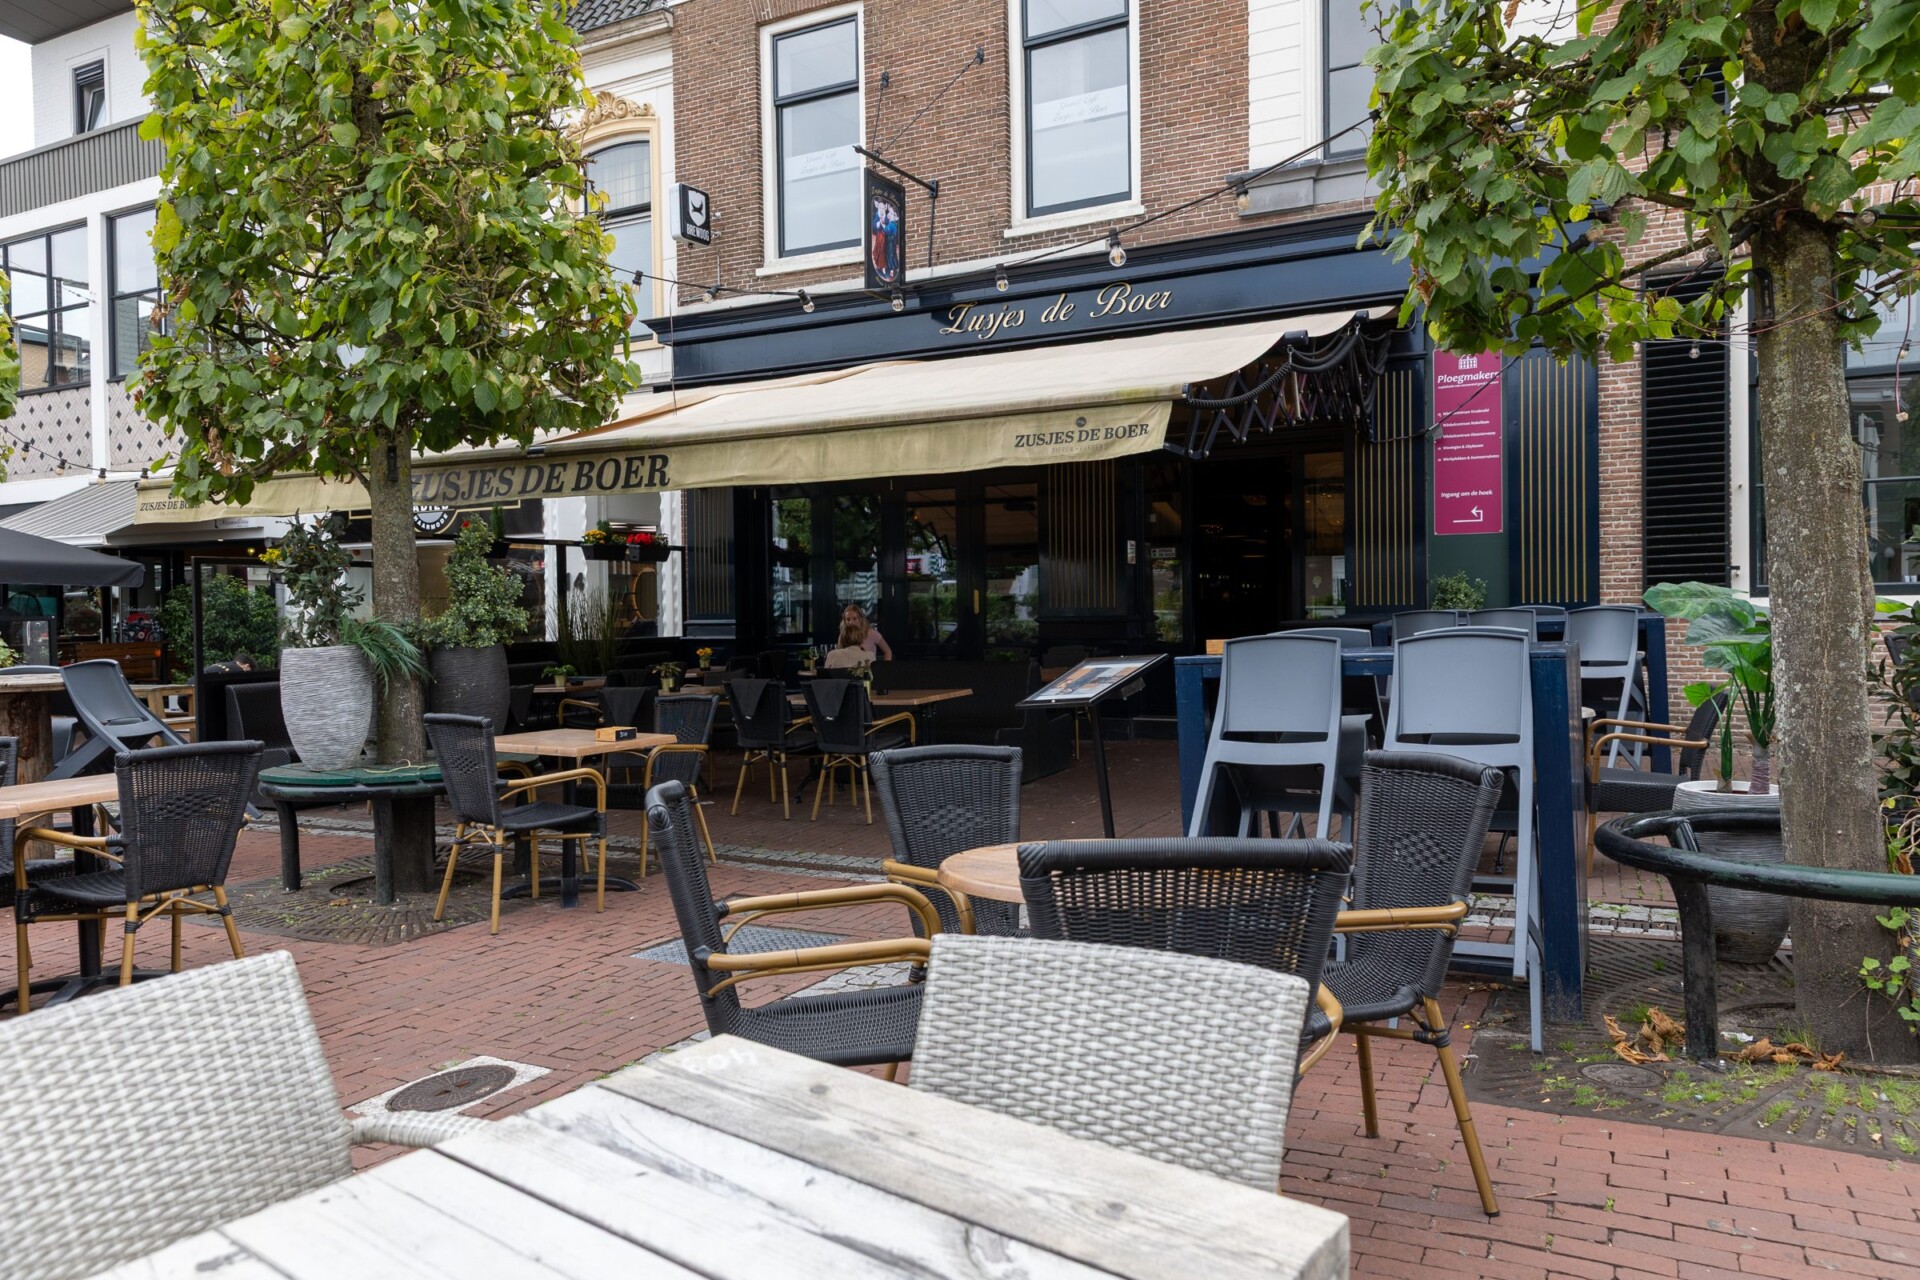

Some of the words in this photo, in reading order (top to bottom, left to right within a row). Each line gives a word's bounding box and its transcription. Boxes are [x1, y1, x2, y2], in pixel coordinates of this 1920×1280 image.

[686, 223, 710, 242] BREWDOG
[939, 300, 1026, 340] Zusjes
[1041, 293, 1076, 324] de
[1090, 281, 1174, 318] Boer
[1014, 430, 1075, 448] ZUSJES
[1077, 428, 1101, 443] DE
[1103, 423, 1150, 440] BOER
[518, 463, 568, 495] DE
[571, 454, 671, 491] BOER
[140, 501, 167, 512] ZUSJES
[167, 500, 179, 510] DE
[1440, 491, 1460, 499] Ingang
